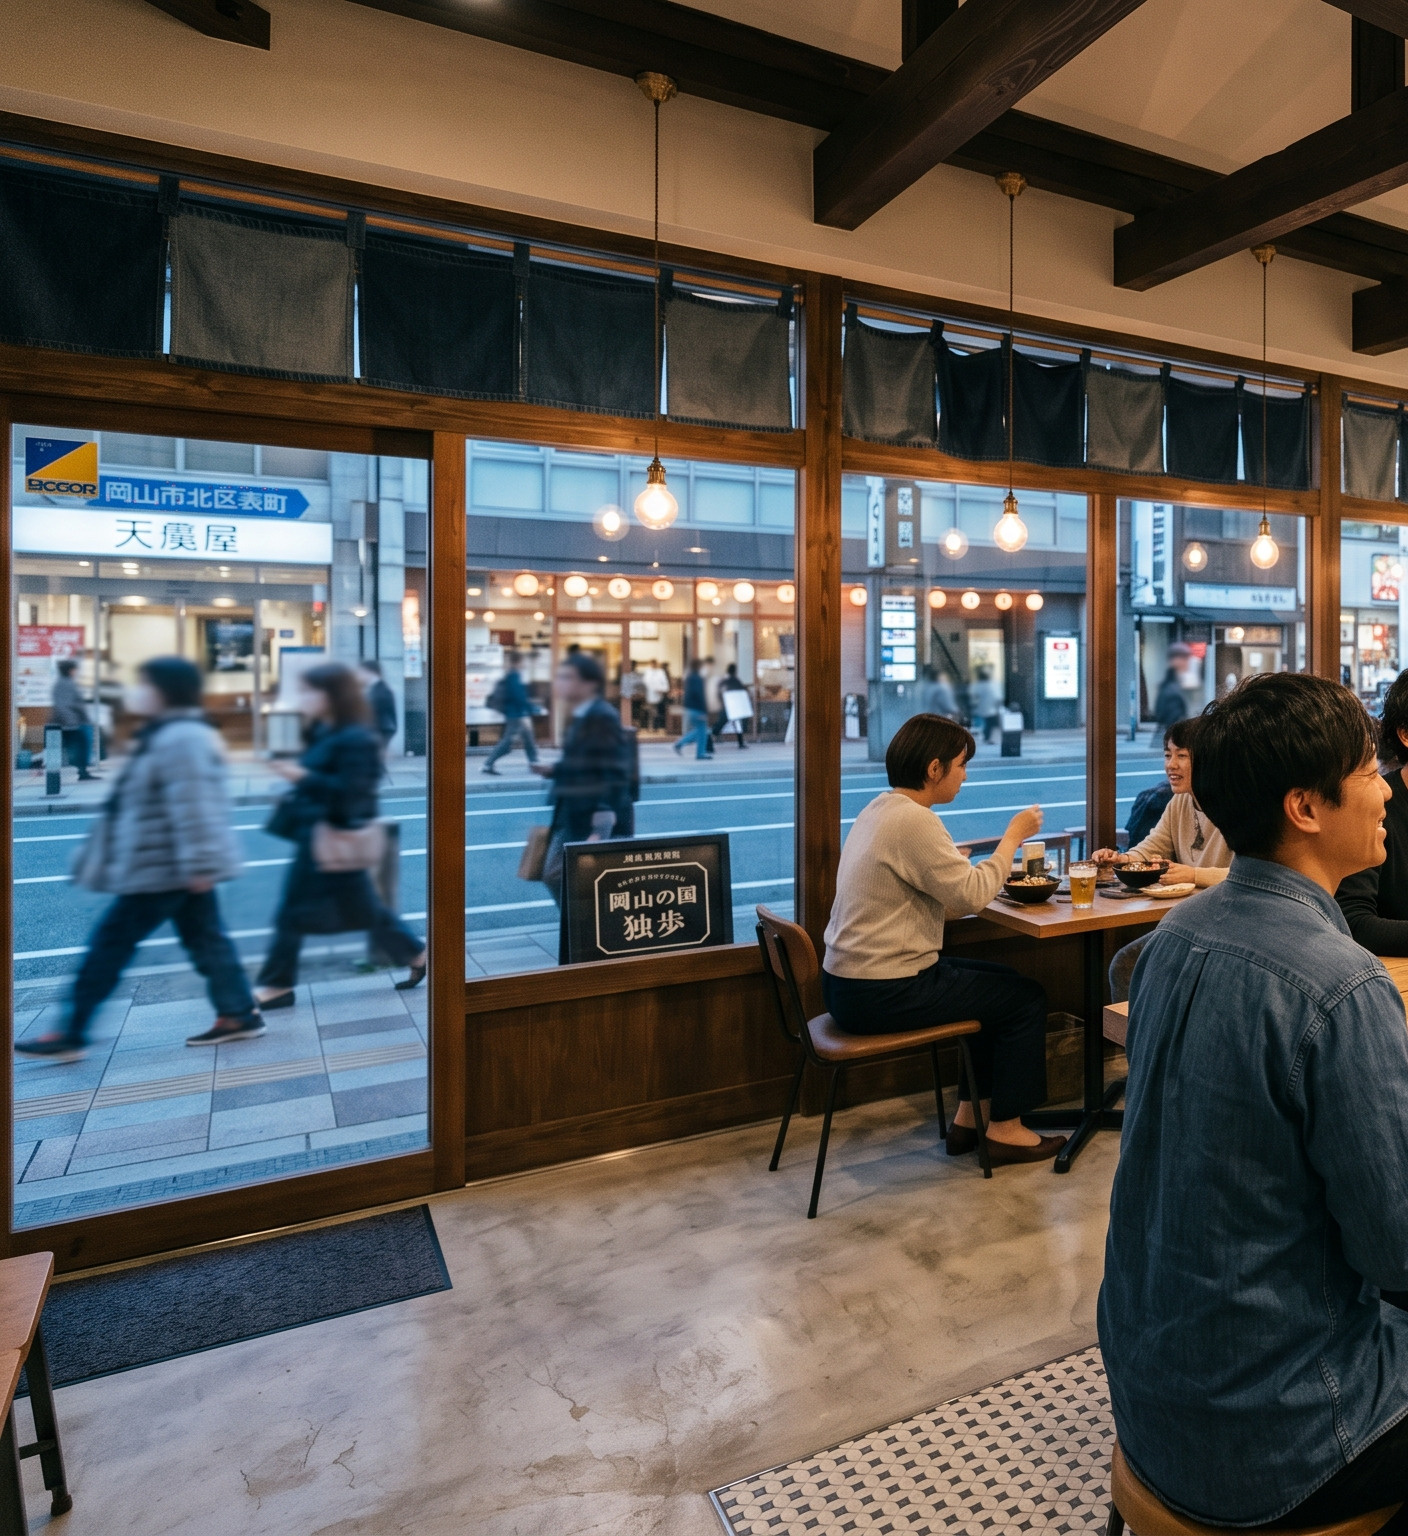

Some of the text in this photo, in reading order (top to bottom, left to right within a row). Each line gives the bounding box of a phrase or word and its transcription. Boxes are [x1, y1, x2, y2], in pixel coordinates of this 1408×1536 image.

[105, 481, 288, 514] 岡山市北区表町
[609, 885, 697, 912] 岡山の国
[623, 909, 685, 942] 独歩
